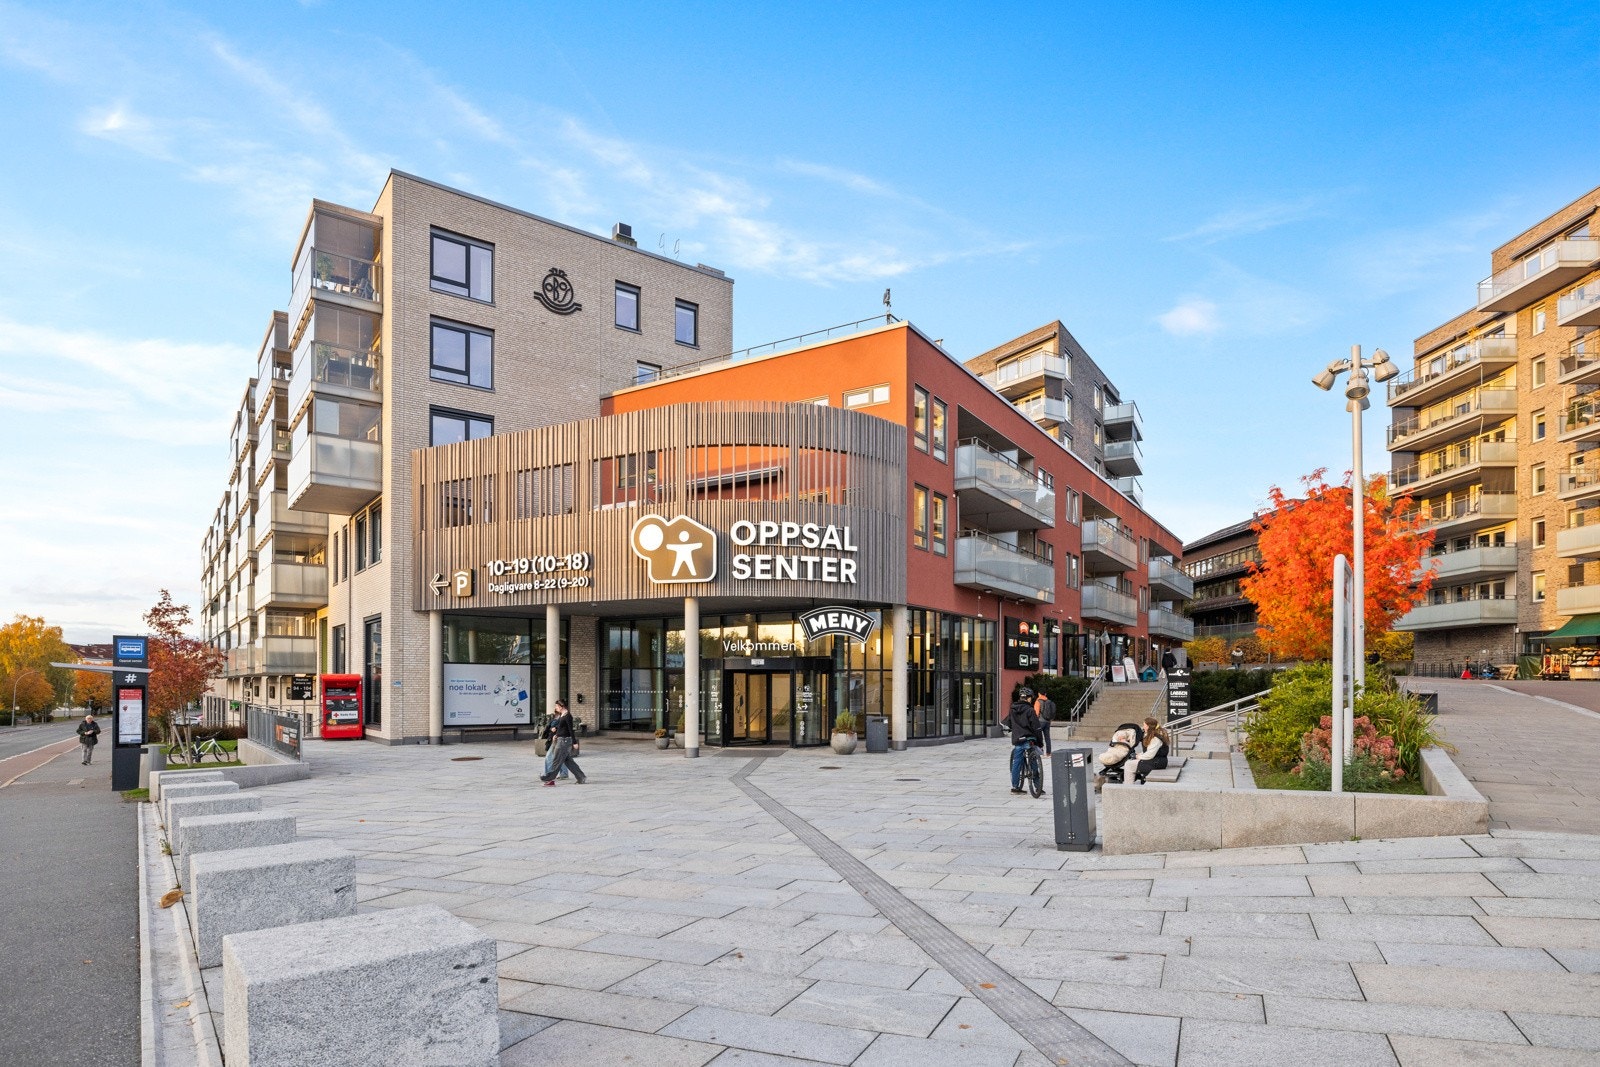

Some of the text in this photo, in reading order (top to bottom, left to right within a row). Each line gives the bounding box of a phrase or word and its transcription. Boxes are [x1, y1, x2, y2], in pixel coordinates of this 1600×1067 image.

[730, 520, 858, 551] OPPSAL
[487, 551, 589, 576] 10-19 (10-18)
[732, 554, 857, 583] SENTER
[456, 576, 468, 596] P
[488, 576, 589, 594] Dagligvare 8-22 (9-20)
[808, 612, 869, 633] MENY
[722, 640, 797, 652] Velkommen
